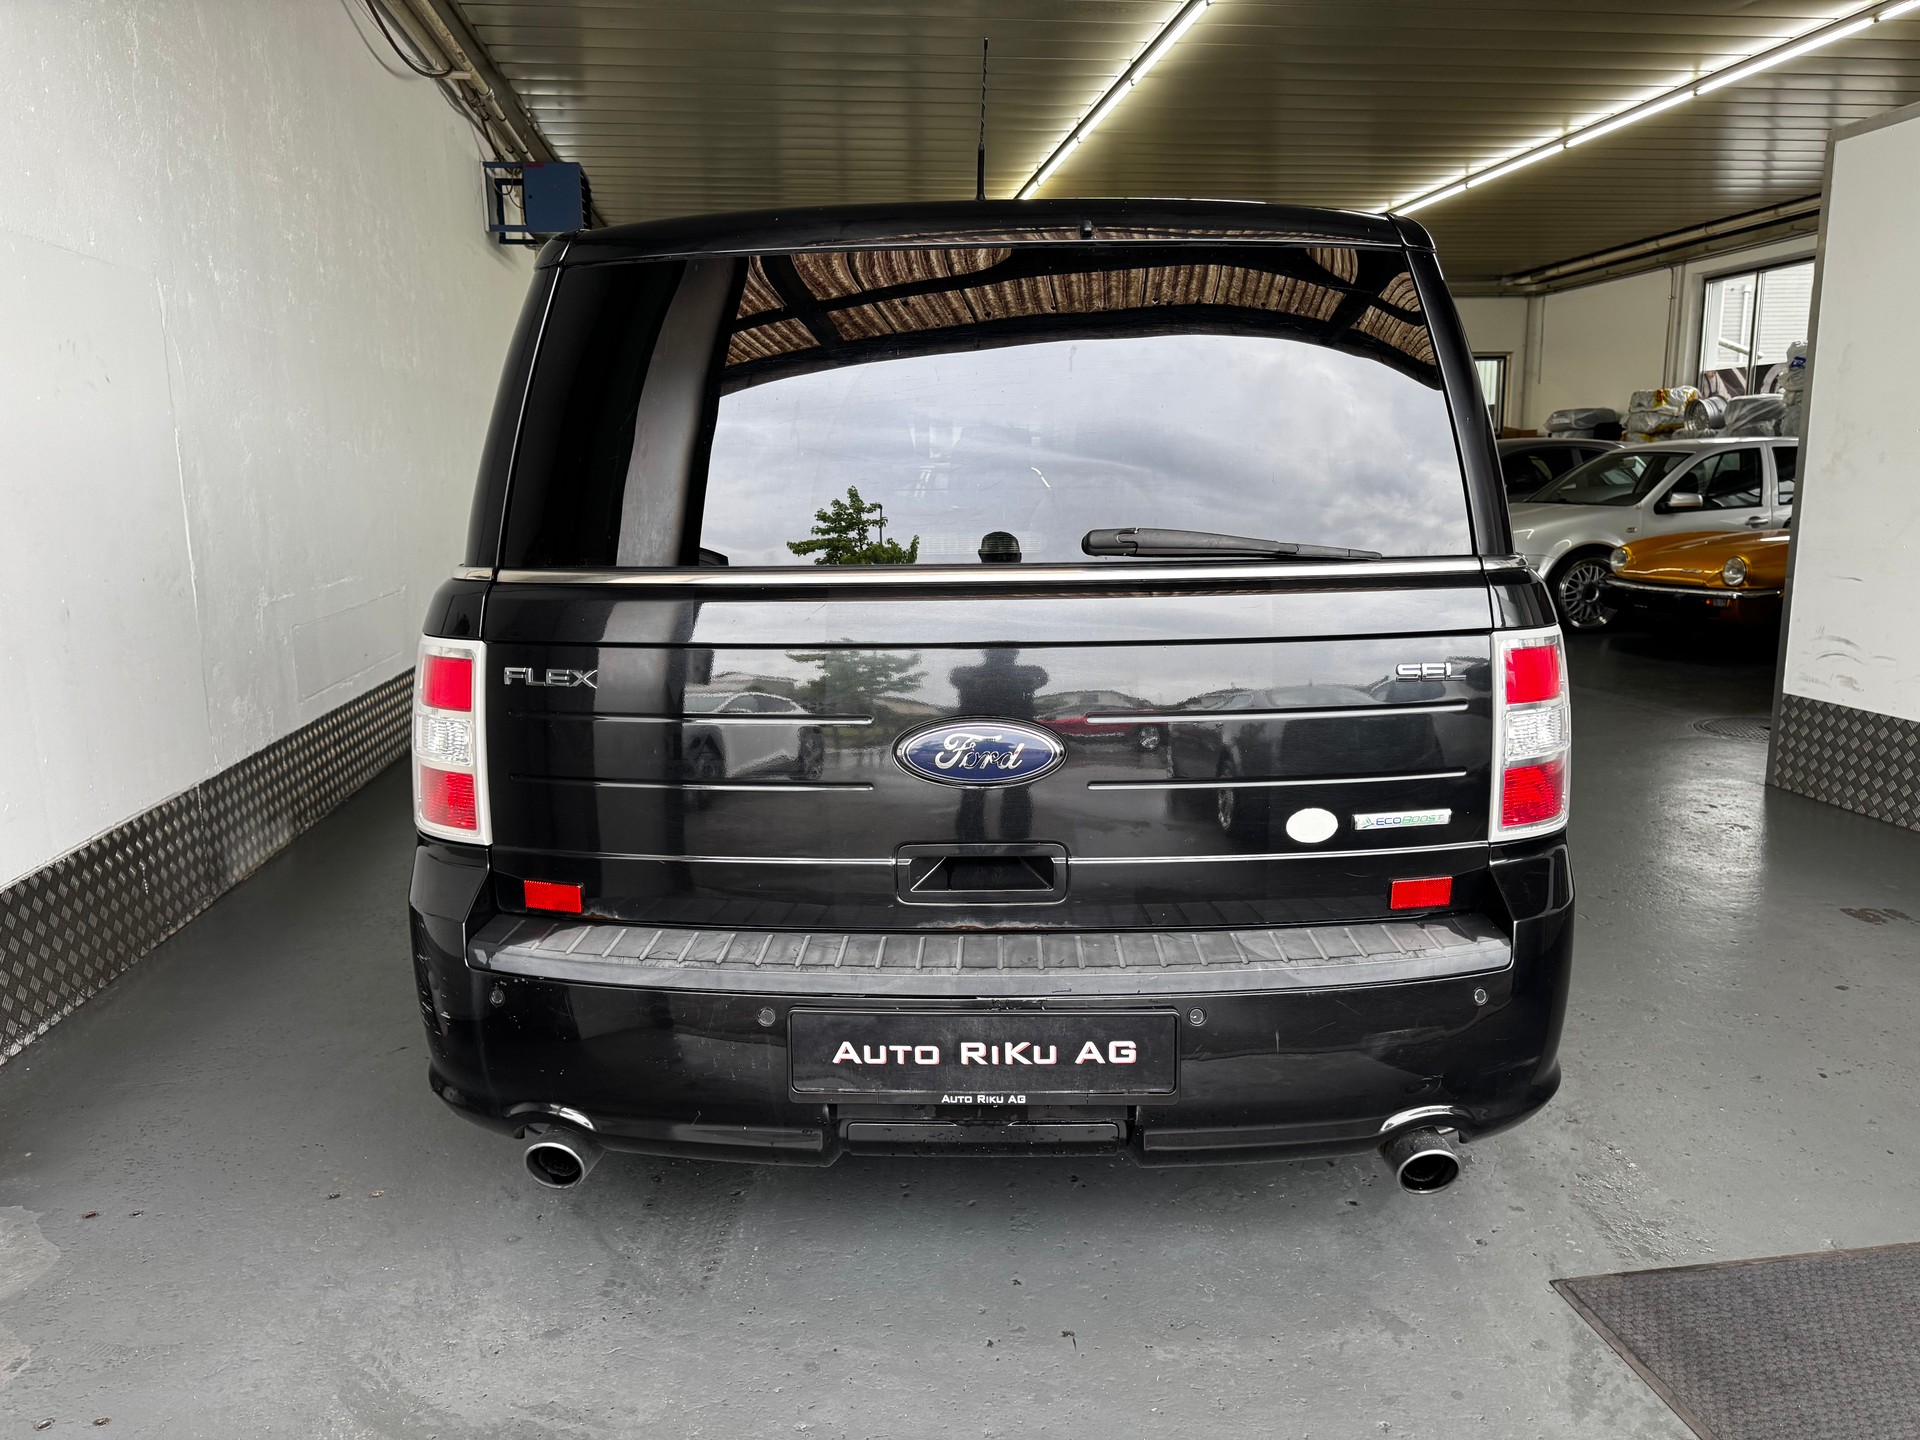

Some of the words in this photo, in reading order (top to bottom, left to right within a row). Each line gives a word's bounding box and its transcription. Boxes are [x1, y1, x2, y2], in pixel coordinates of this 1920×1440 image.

[503, 666, 598, 689] FLEX
[1396, 662, 1467, 682] SEL
[935, 732, 1025, 770] Ford
[1075, 1040, 1137, 1065] AG
[1007, 1094, 1026, 1104] AG
